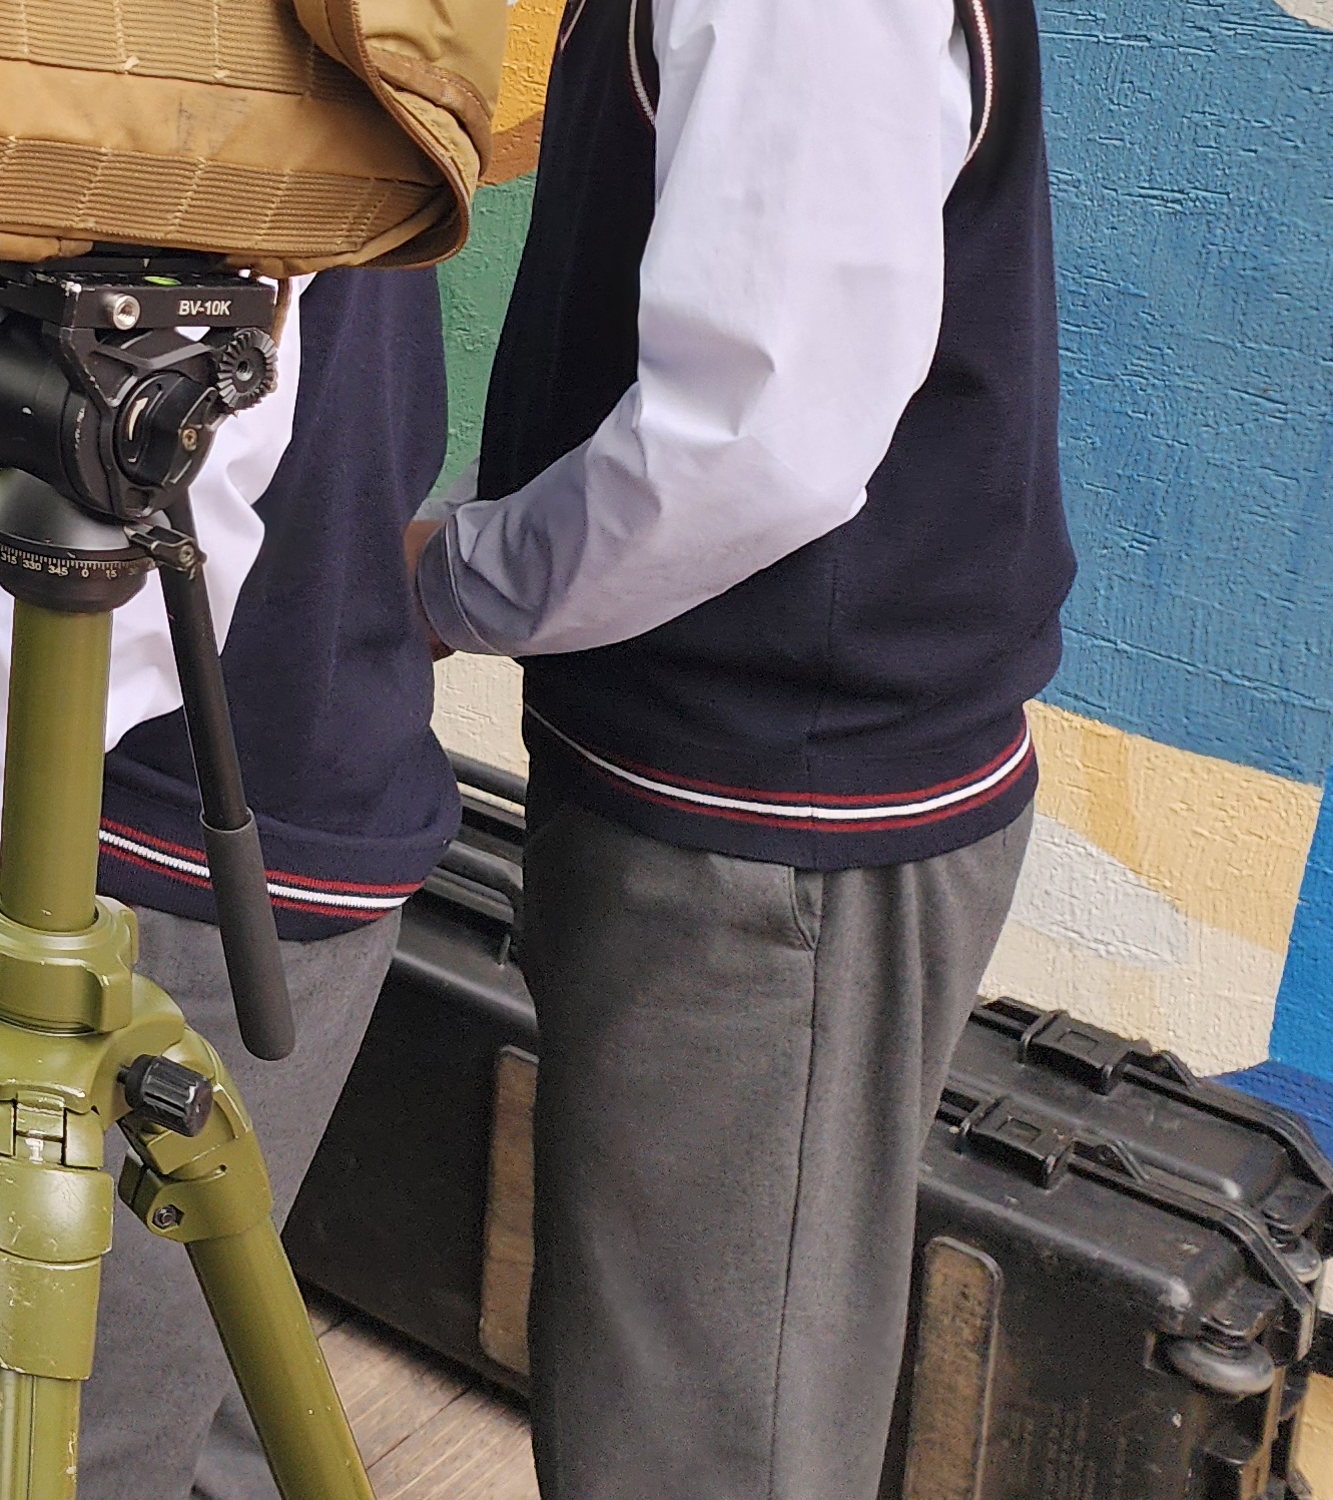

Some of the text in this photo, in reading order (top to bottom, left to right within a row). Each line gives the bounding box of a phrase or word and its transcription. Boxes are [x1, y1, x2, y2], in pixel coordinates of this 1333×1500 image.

[178, 300, 232, 316] BV-10K
[0, 552, 18, 565] 315
[23, 559, 42, 571] 330
[47, 565, 68, 577] 345
[81, 569, 89, 578] 0
[105, 569, 118, 579] 15
